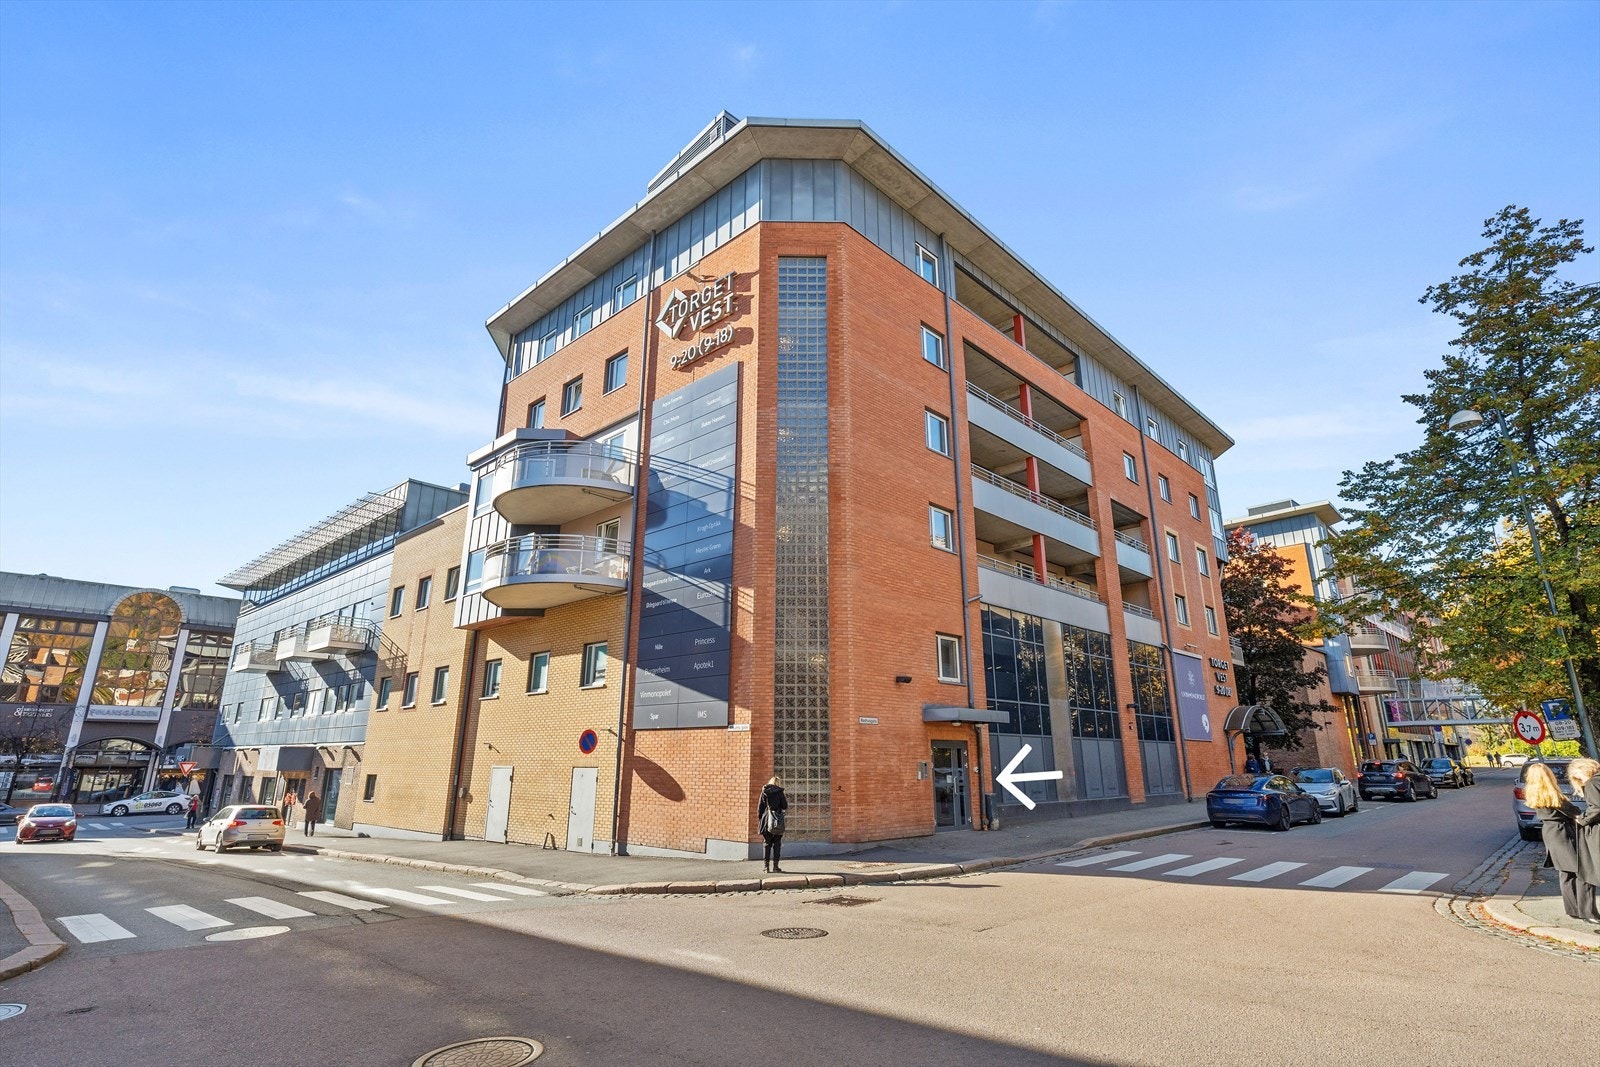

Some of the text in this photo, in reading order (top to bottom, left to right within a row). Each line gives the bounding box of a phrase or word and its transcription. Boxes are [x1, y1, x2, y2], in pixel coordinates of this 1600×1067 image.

[669, 270, 737, 323] TORGET
[690, 292, 734, 332] VEST
[670, 323, 733, 369] 9-20 (9-18)
[695, 637, 715, 646] Princess
[640, 689, 671, 699] Vinmonopolet
